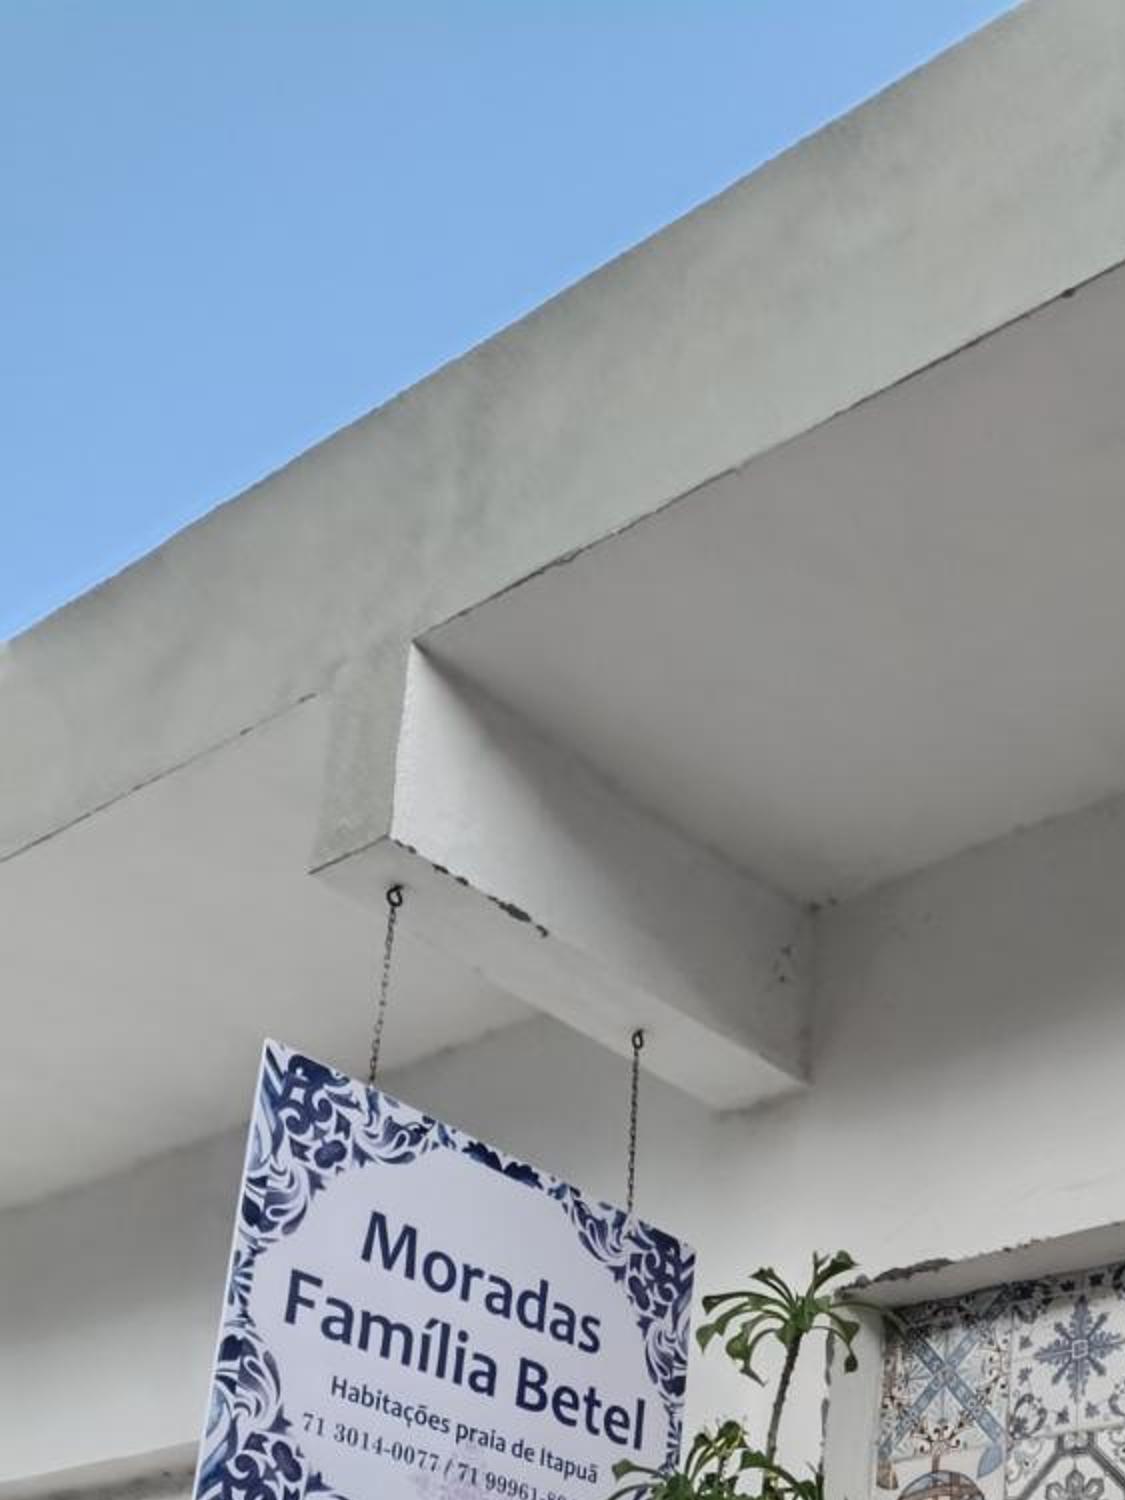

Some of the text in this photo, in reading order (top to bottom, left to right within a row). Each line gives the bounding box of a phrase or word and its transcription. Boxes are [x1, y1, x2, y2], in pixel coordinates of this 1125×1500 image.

[361, 1210, 601, 1354] Moradas
[284, 1268, 646, 1450] Família Betel
[303, 1412, 324, 1436] 71
[333, 1423, 440, 1473] 3014-0077
[458, 1463, 478, 1485] 71
[331, 1375, 599, 1484] Habitações praia de Itapuã
